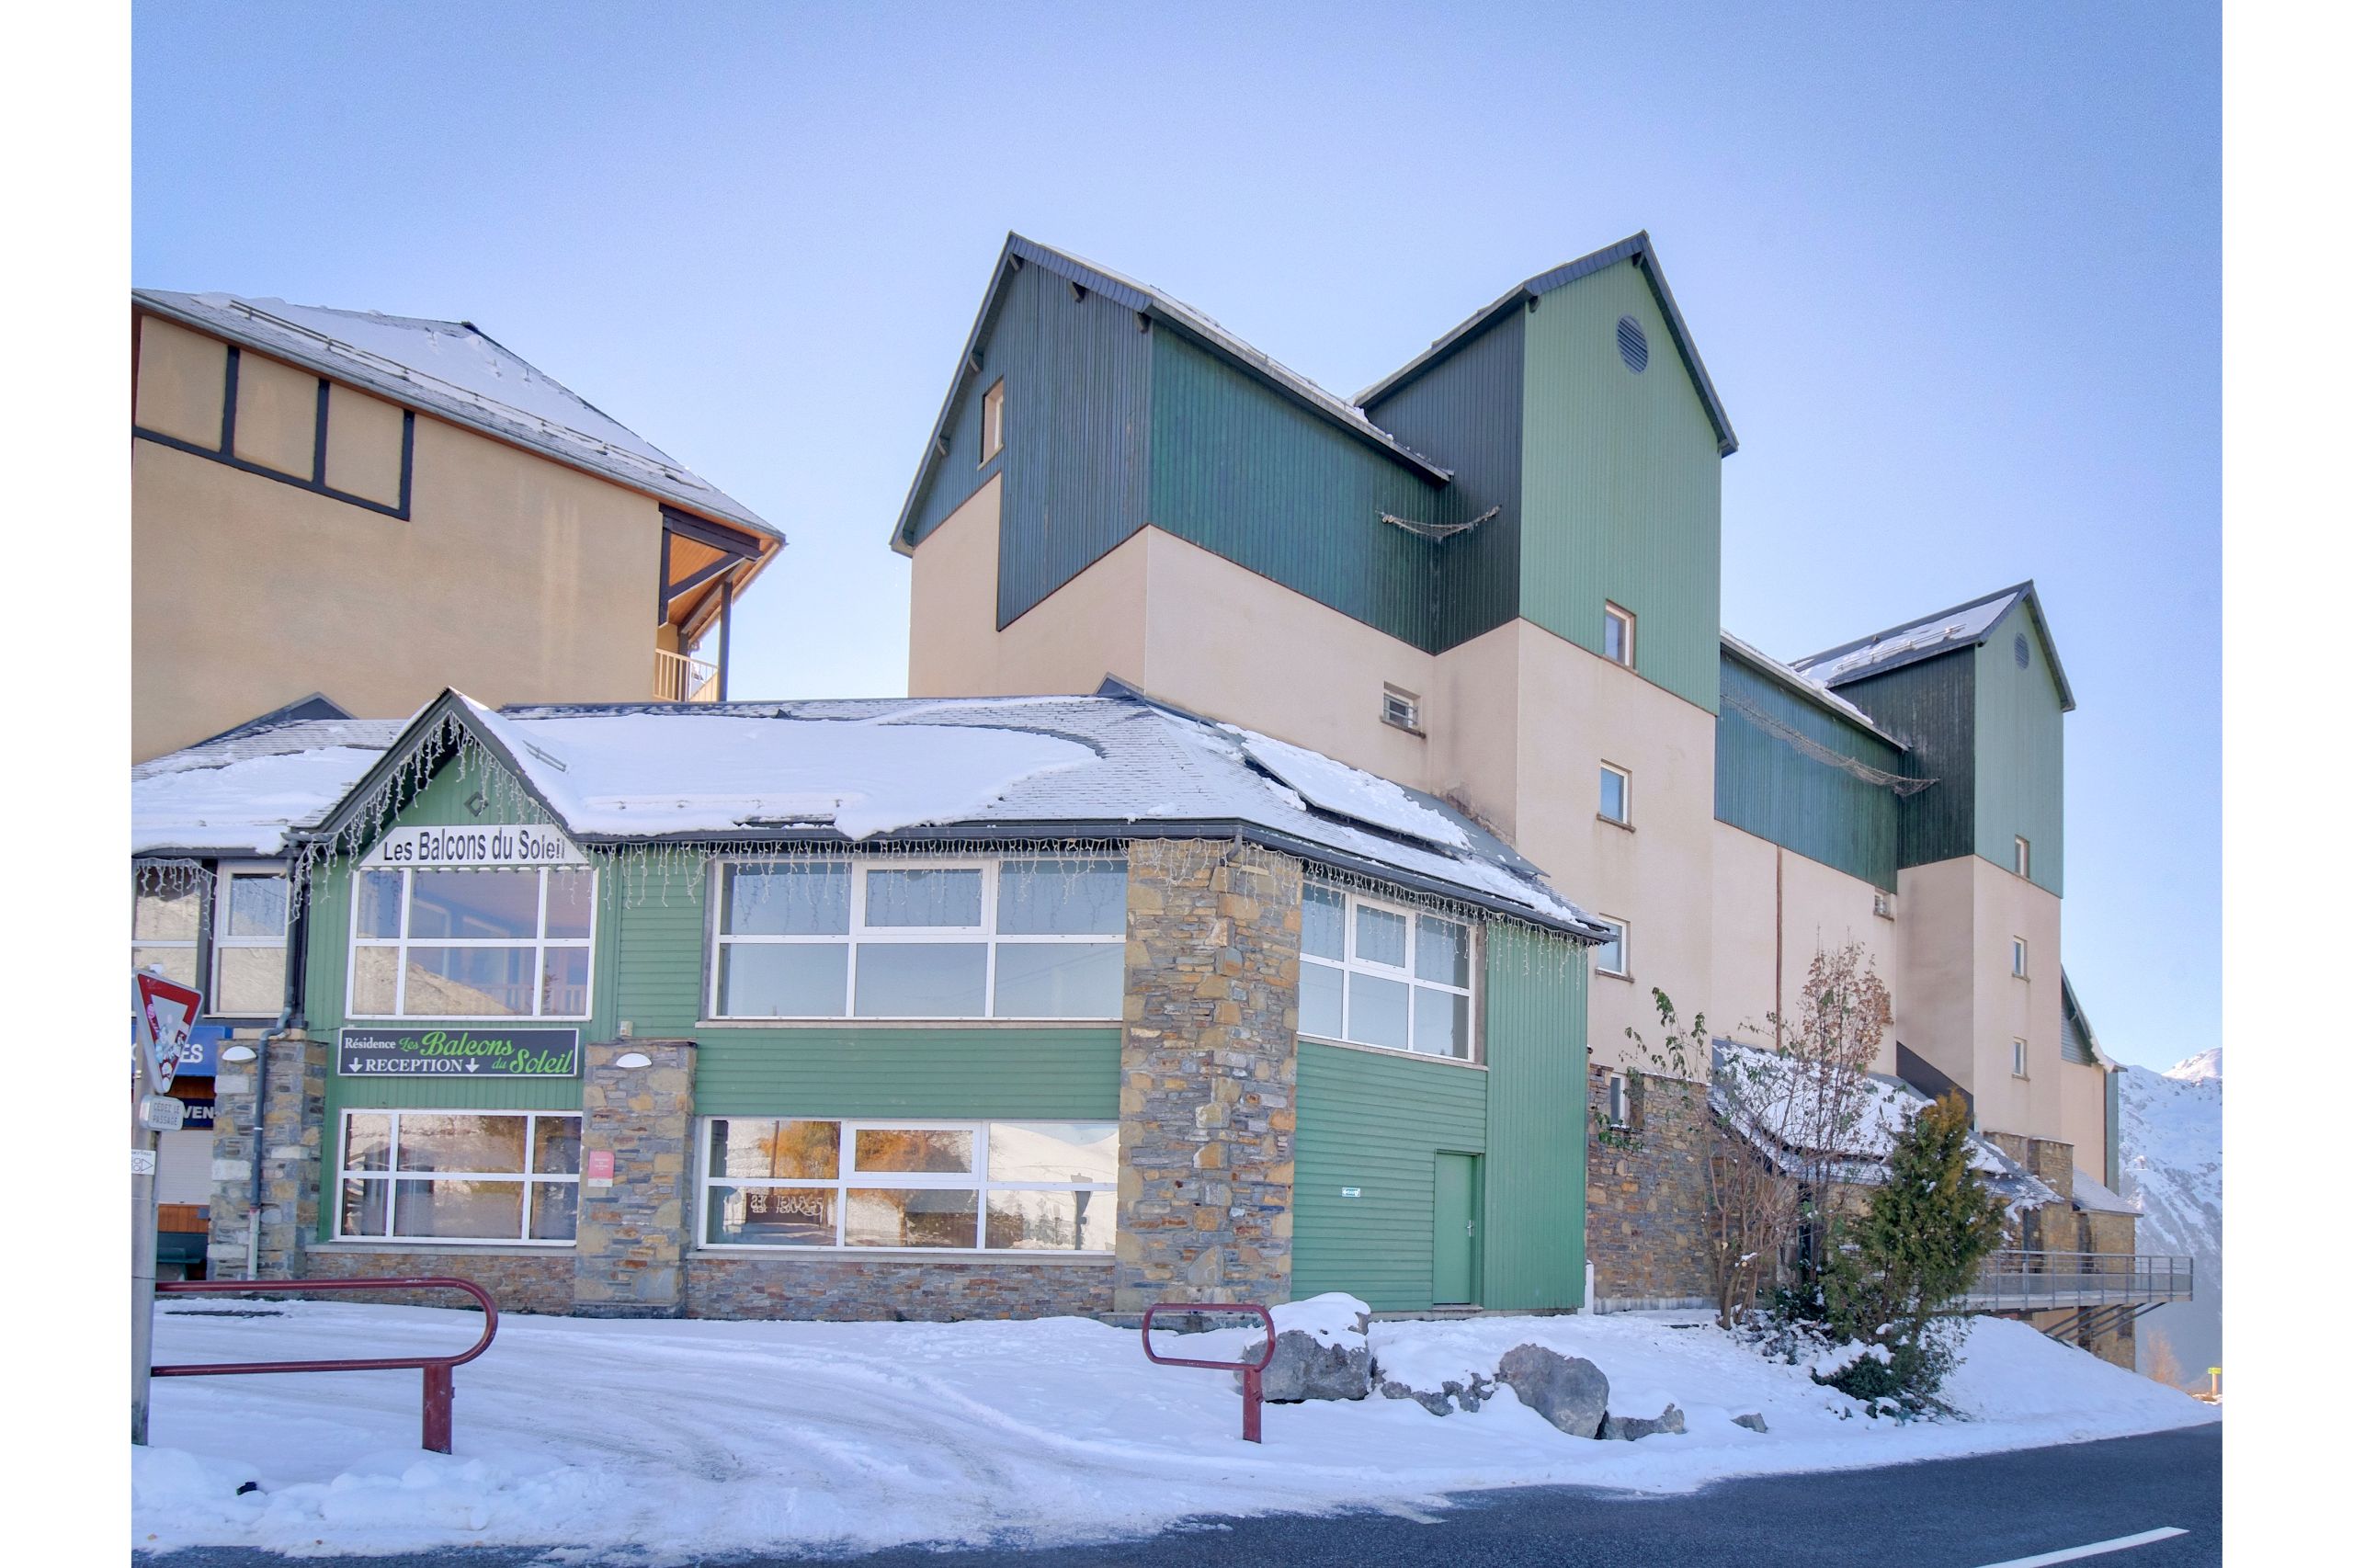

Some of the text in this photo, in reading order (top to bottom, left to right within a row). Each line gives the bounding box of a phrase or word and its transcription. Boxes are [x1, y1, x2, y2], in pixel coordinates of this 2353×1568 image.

[383, 827, 565, 861] Les Balcons du Soleil
[345, 1037, 396, 1050] Résidence
[399, 1037, 419, 1052] Les
[366, 1059, 463, 1073] RECEPTION
[491, 1049, 574, 1074] du Soleil
[174, 1105, 181, 1115] LE
[153, 1114, 178, 1126] PASSAGE
